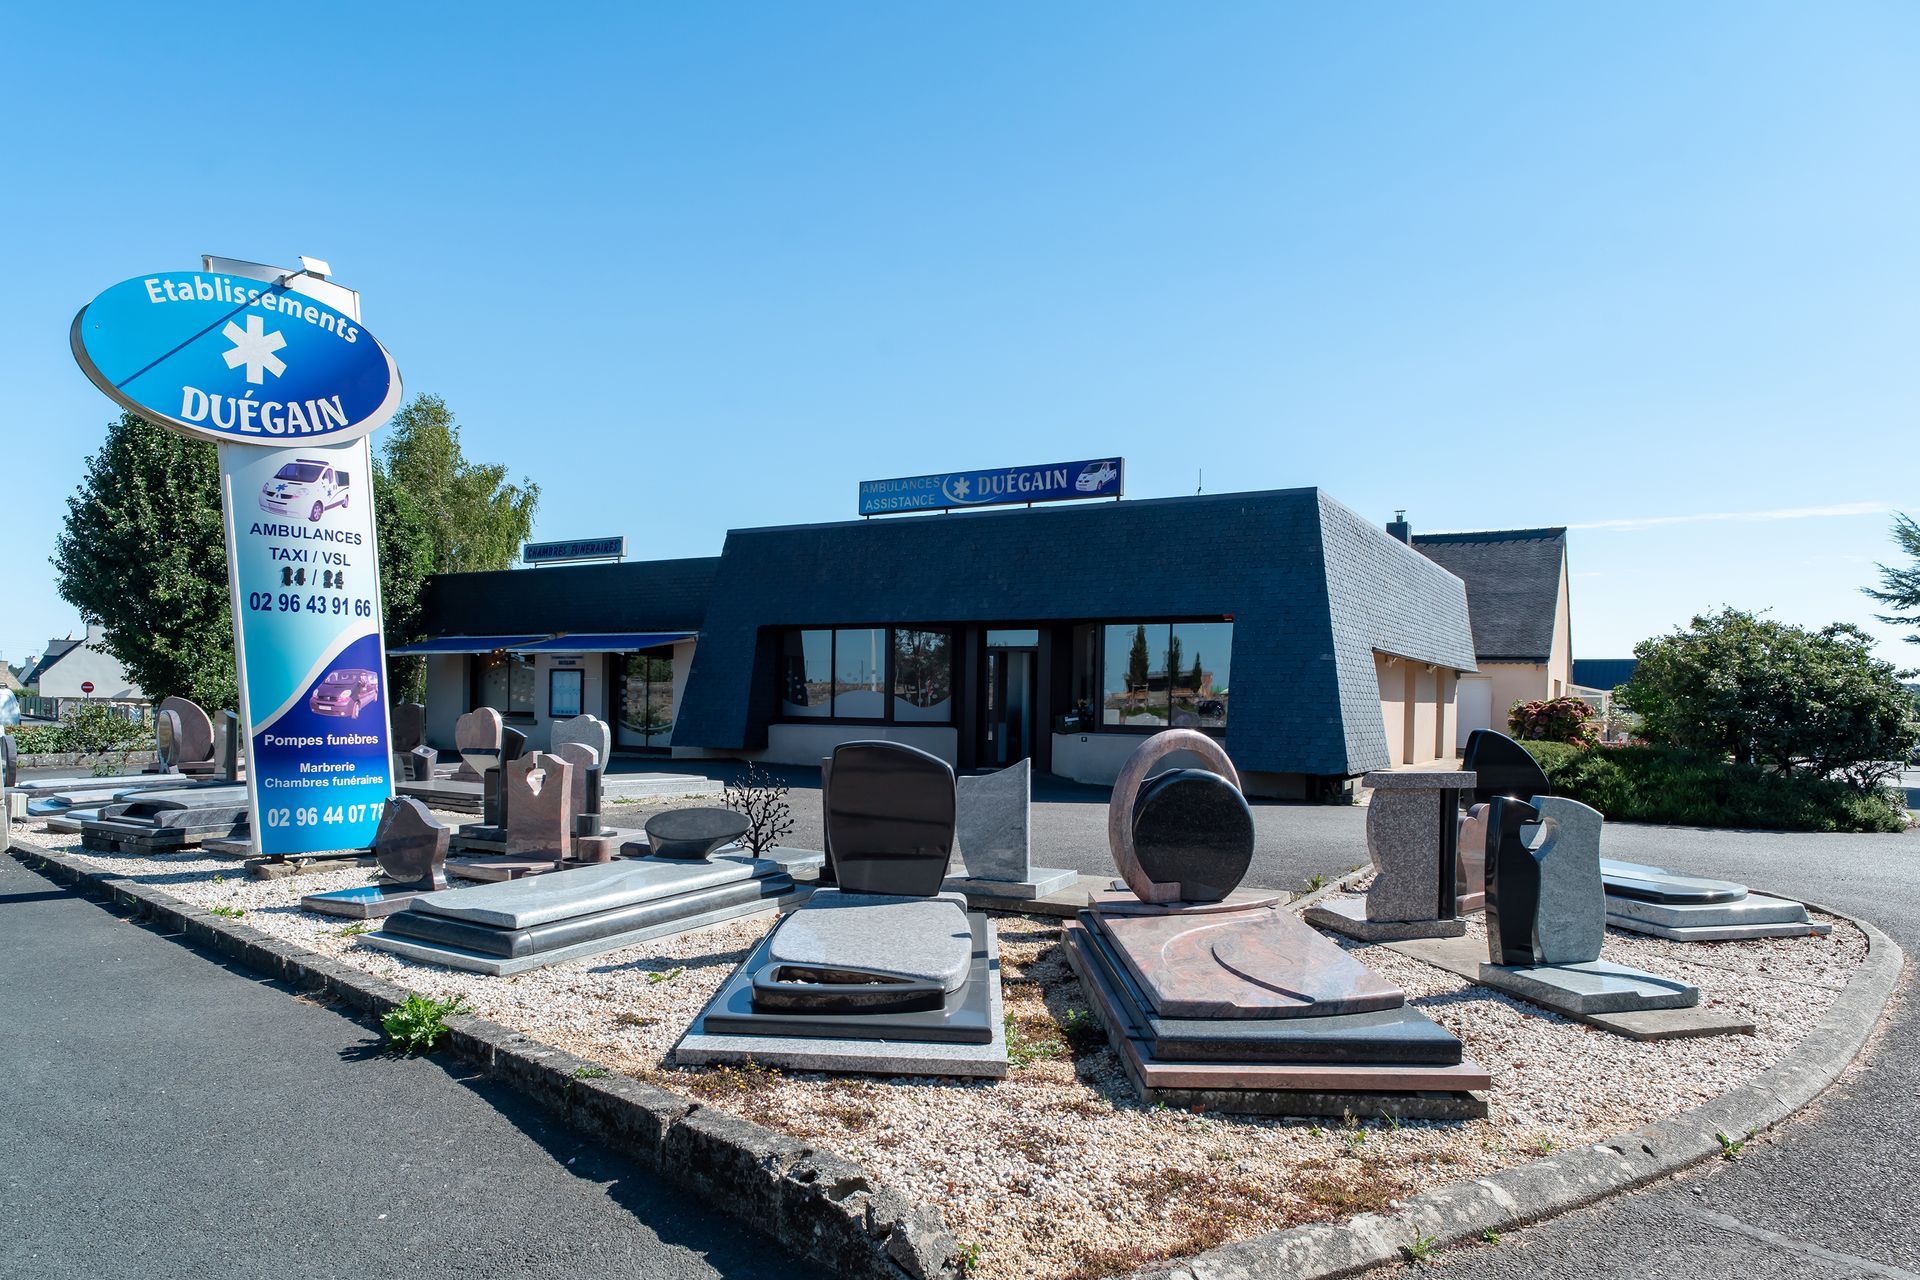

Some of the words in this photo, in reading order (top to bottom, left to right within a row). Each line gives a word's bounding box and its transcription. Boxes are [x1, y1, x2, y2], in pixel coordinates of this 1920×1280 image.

[144, 276, 359, 344] Etablissements
[181, 385, 349, 434] DUÉGAIN
[862, 477, 941, 494] AMBULANCES
[978, 467, 1068, 496] DUÉGAIN
[865, 494, 936, 511] ASSISTANCE
[249, 522, 362, 545] AMBULANCES
[269, 547, 308, 562] TAXI
[322, 551, 351, 566] VSL
[527, 545, 567, 559] CHAMBRES
[249, 591, 272, 611] 02
[279, 593, 301, 613] 96
[306, 594, 327, 614] 43
[332, 596, 349, 615] 91
[355, 598, 371, 617] 66
[264, 734, 323, 748] Pompes
[327, 733, 379, 746] funèbres
[300, 762, 355, 773] Marbrerie
[264, 778, 329, 789] Chambres
[332, 774, 383, 786] funéraires
[267, 808, 290, 828] 02
[296, 807, 318, 826] 96
[323, 805, 344, 825] 44
[348, 804, 366, 823] 07
